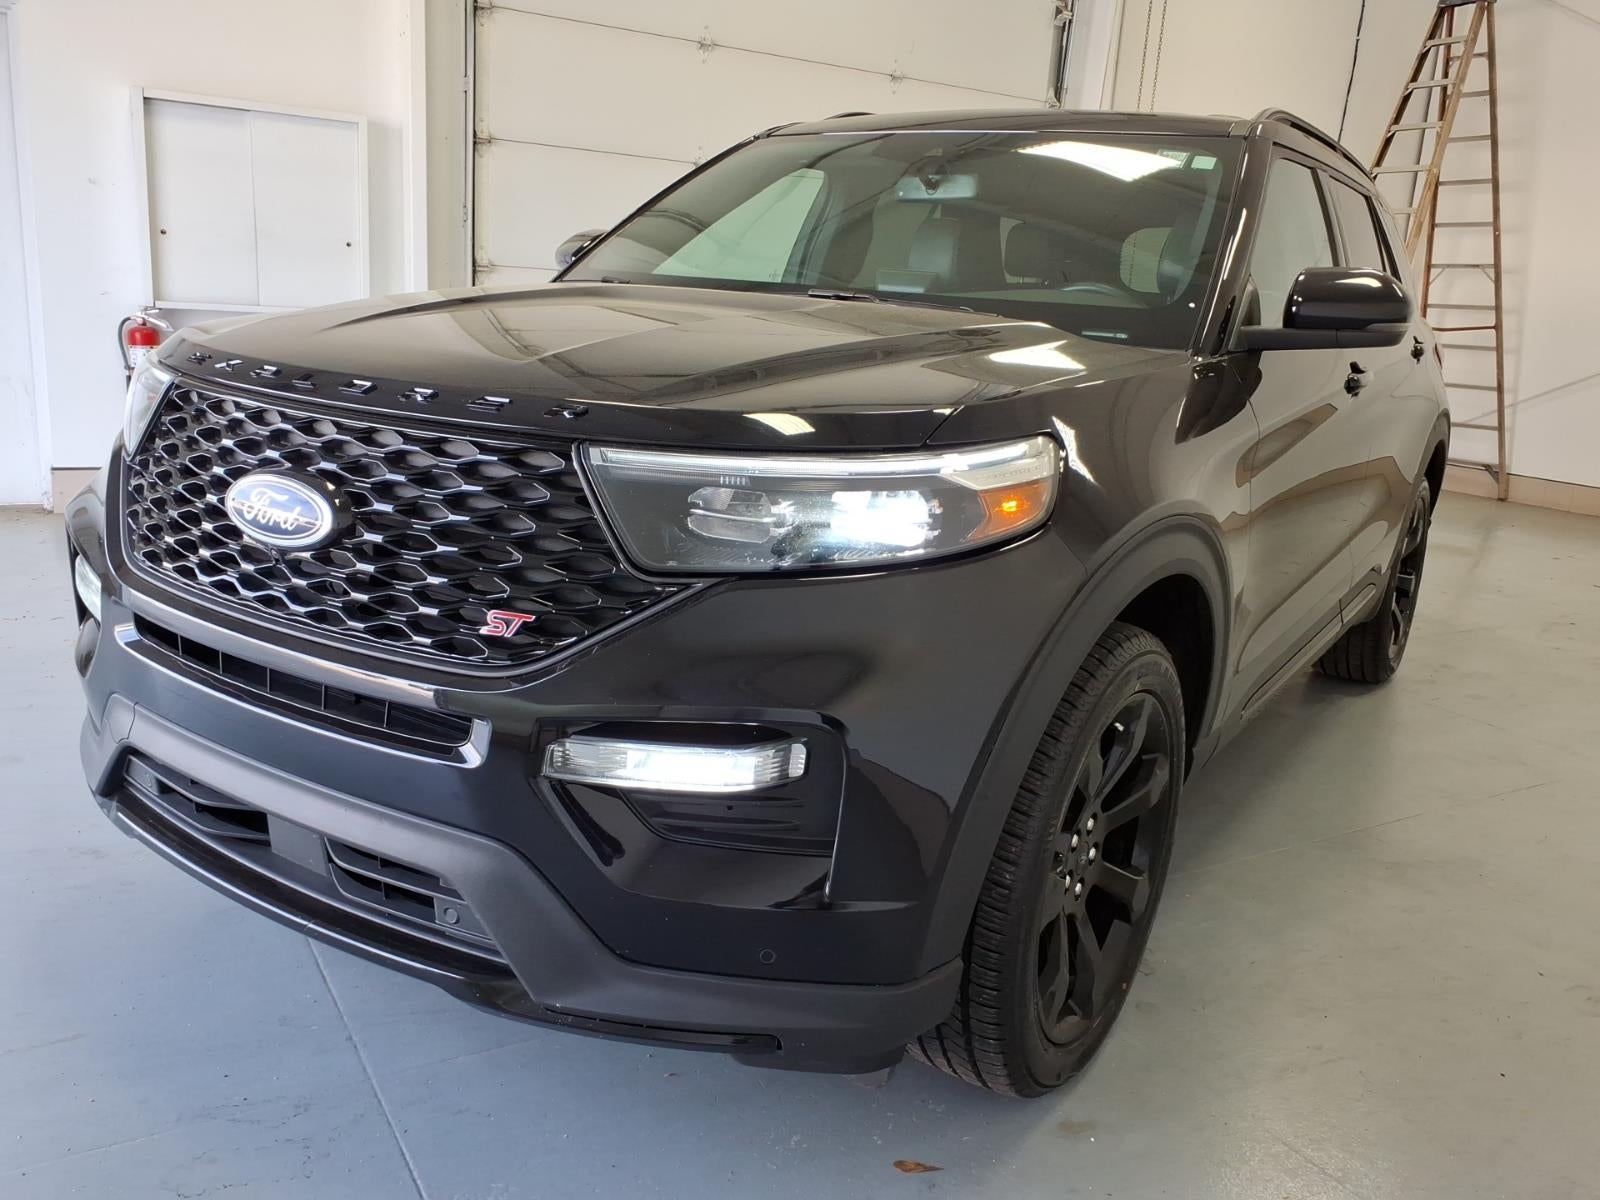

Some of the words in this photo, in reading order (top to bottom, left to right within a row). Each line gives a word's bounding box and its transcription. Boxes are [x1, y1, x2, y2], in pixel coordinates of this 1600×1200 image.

[187, 351, 590, 420] EXPLORER
[240, 486, 304, 532] Ford
[479, 609, 537, 638] ST
